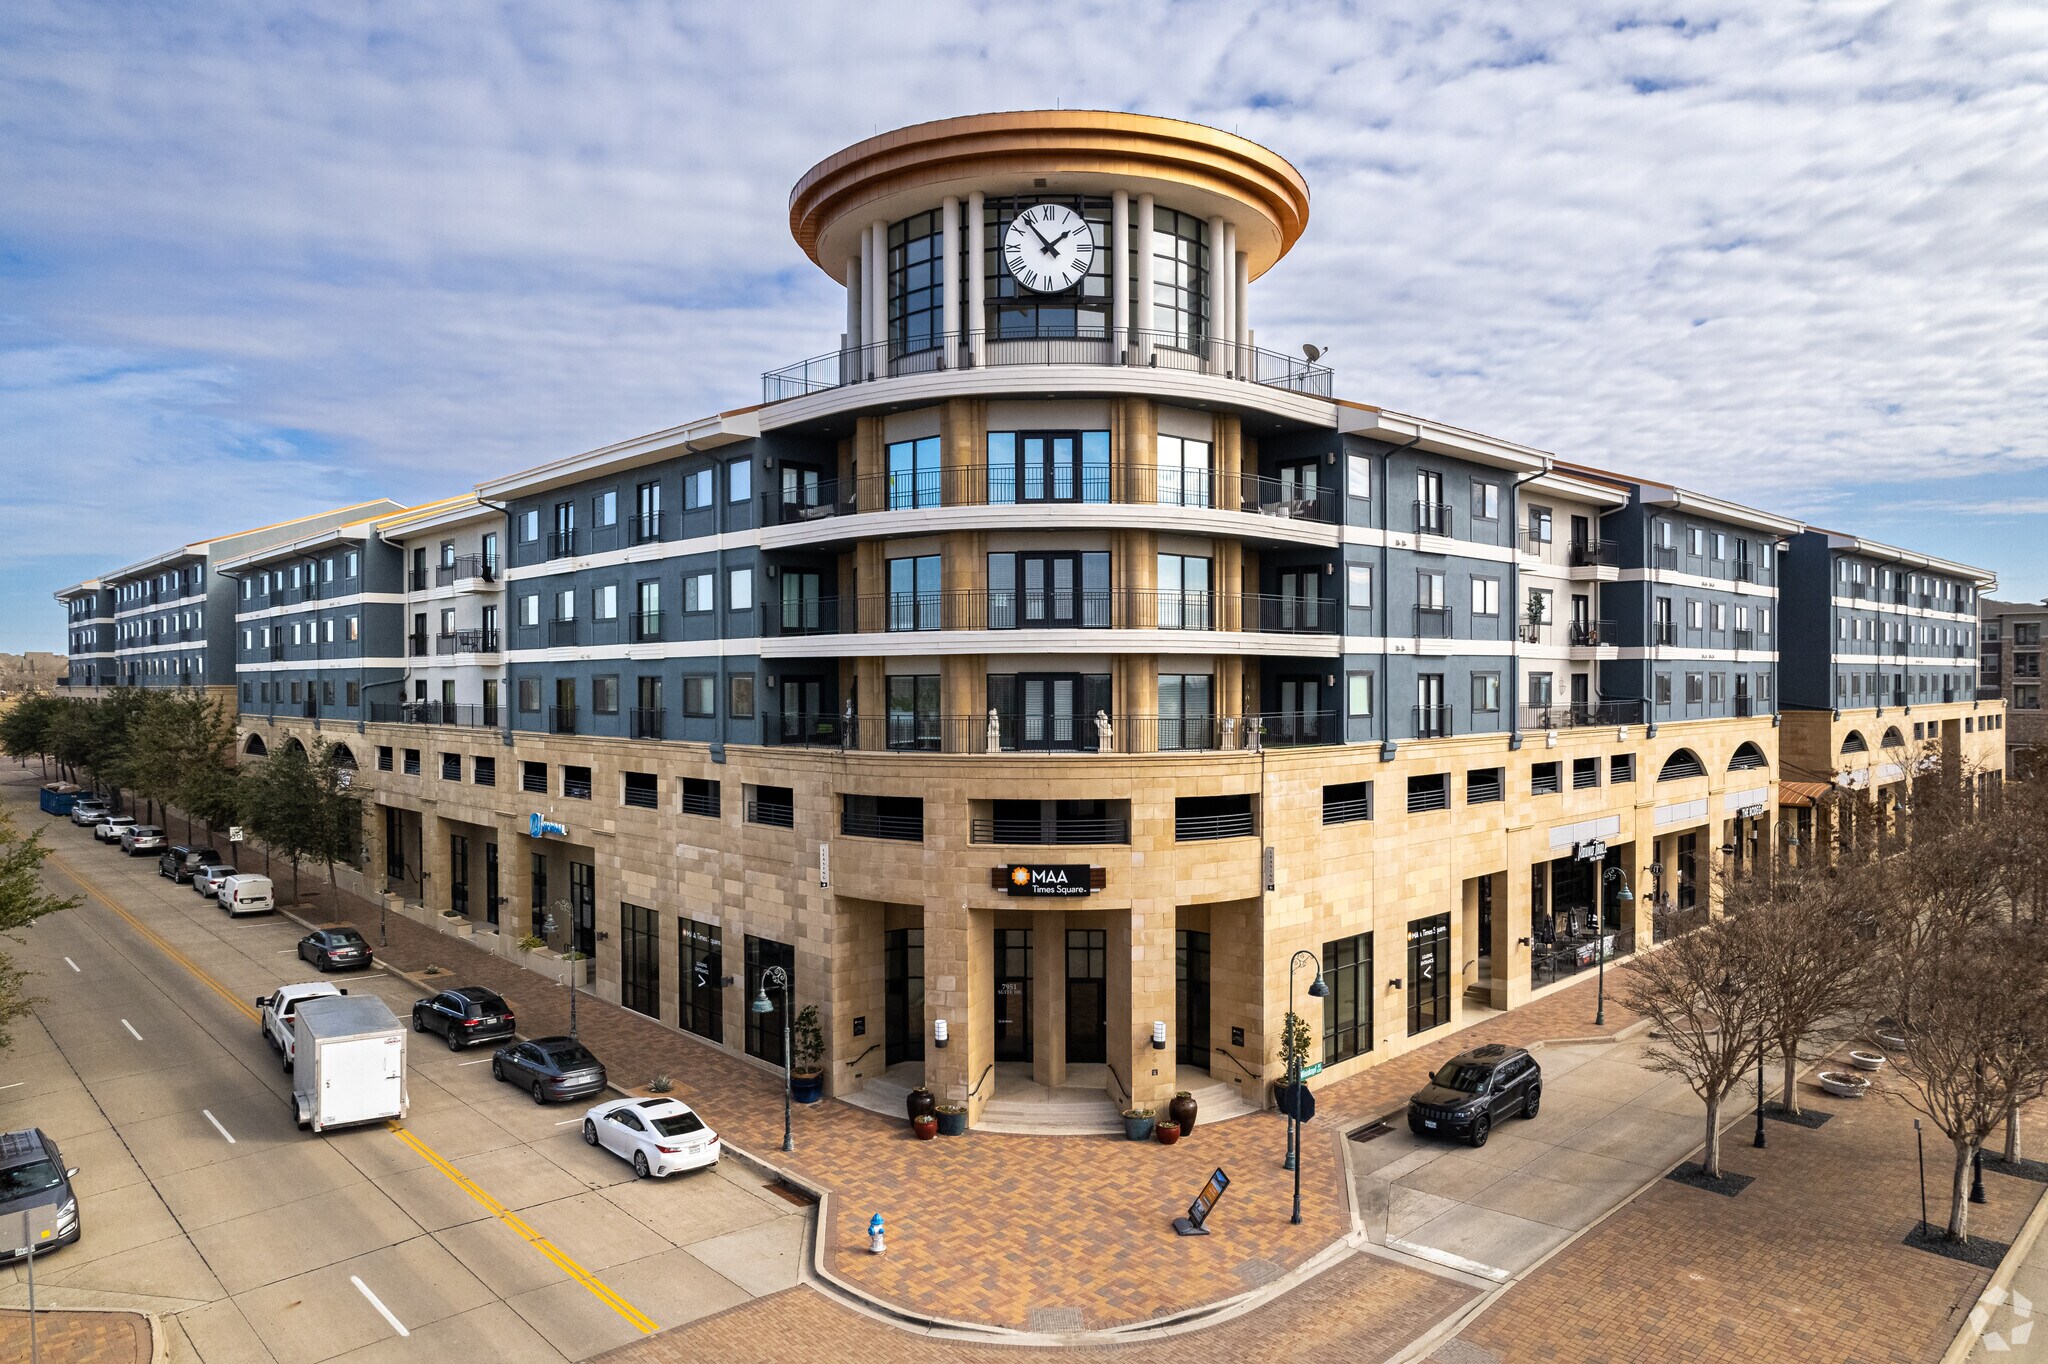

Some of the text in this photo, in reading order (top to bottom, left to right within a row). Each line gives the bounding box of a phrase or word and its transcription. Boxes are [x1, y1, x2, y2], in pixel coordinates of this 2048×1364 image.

[1043, 205, 1055, 221] XII
[1010, 224, 1026, 237] X
[1072, 224, 1087, 236] II
[1005, 243, 1021, 253] IX
[1076, 244, 1092, 252] III
[1008, 255, 1027, 275] VIII
[1022, 269, 1038, 288] VII
[1043, 275, 1053, 291] VI
[1062, 271, 1073, 286] V
[1032, 869, 1068, 883] MAA
[1032, 884, 1055, 894] Times
